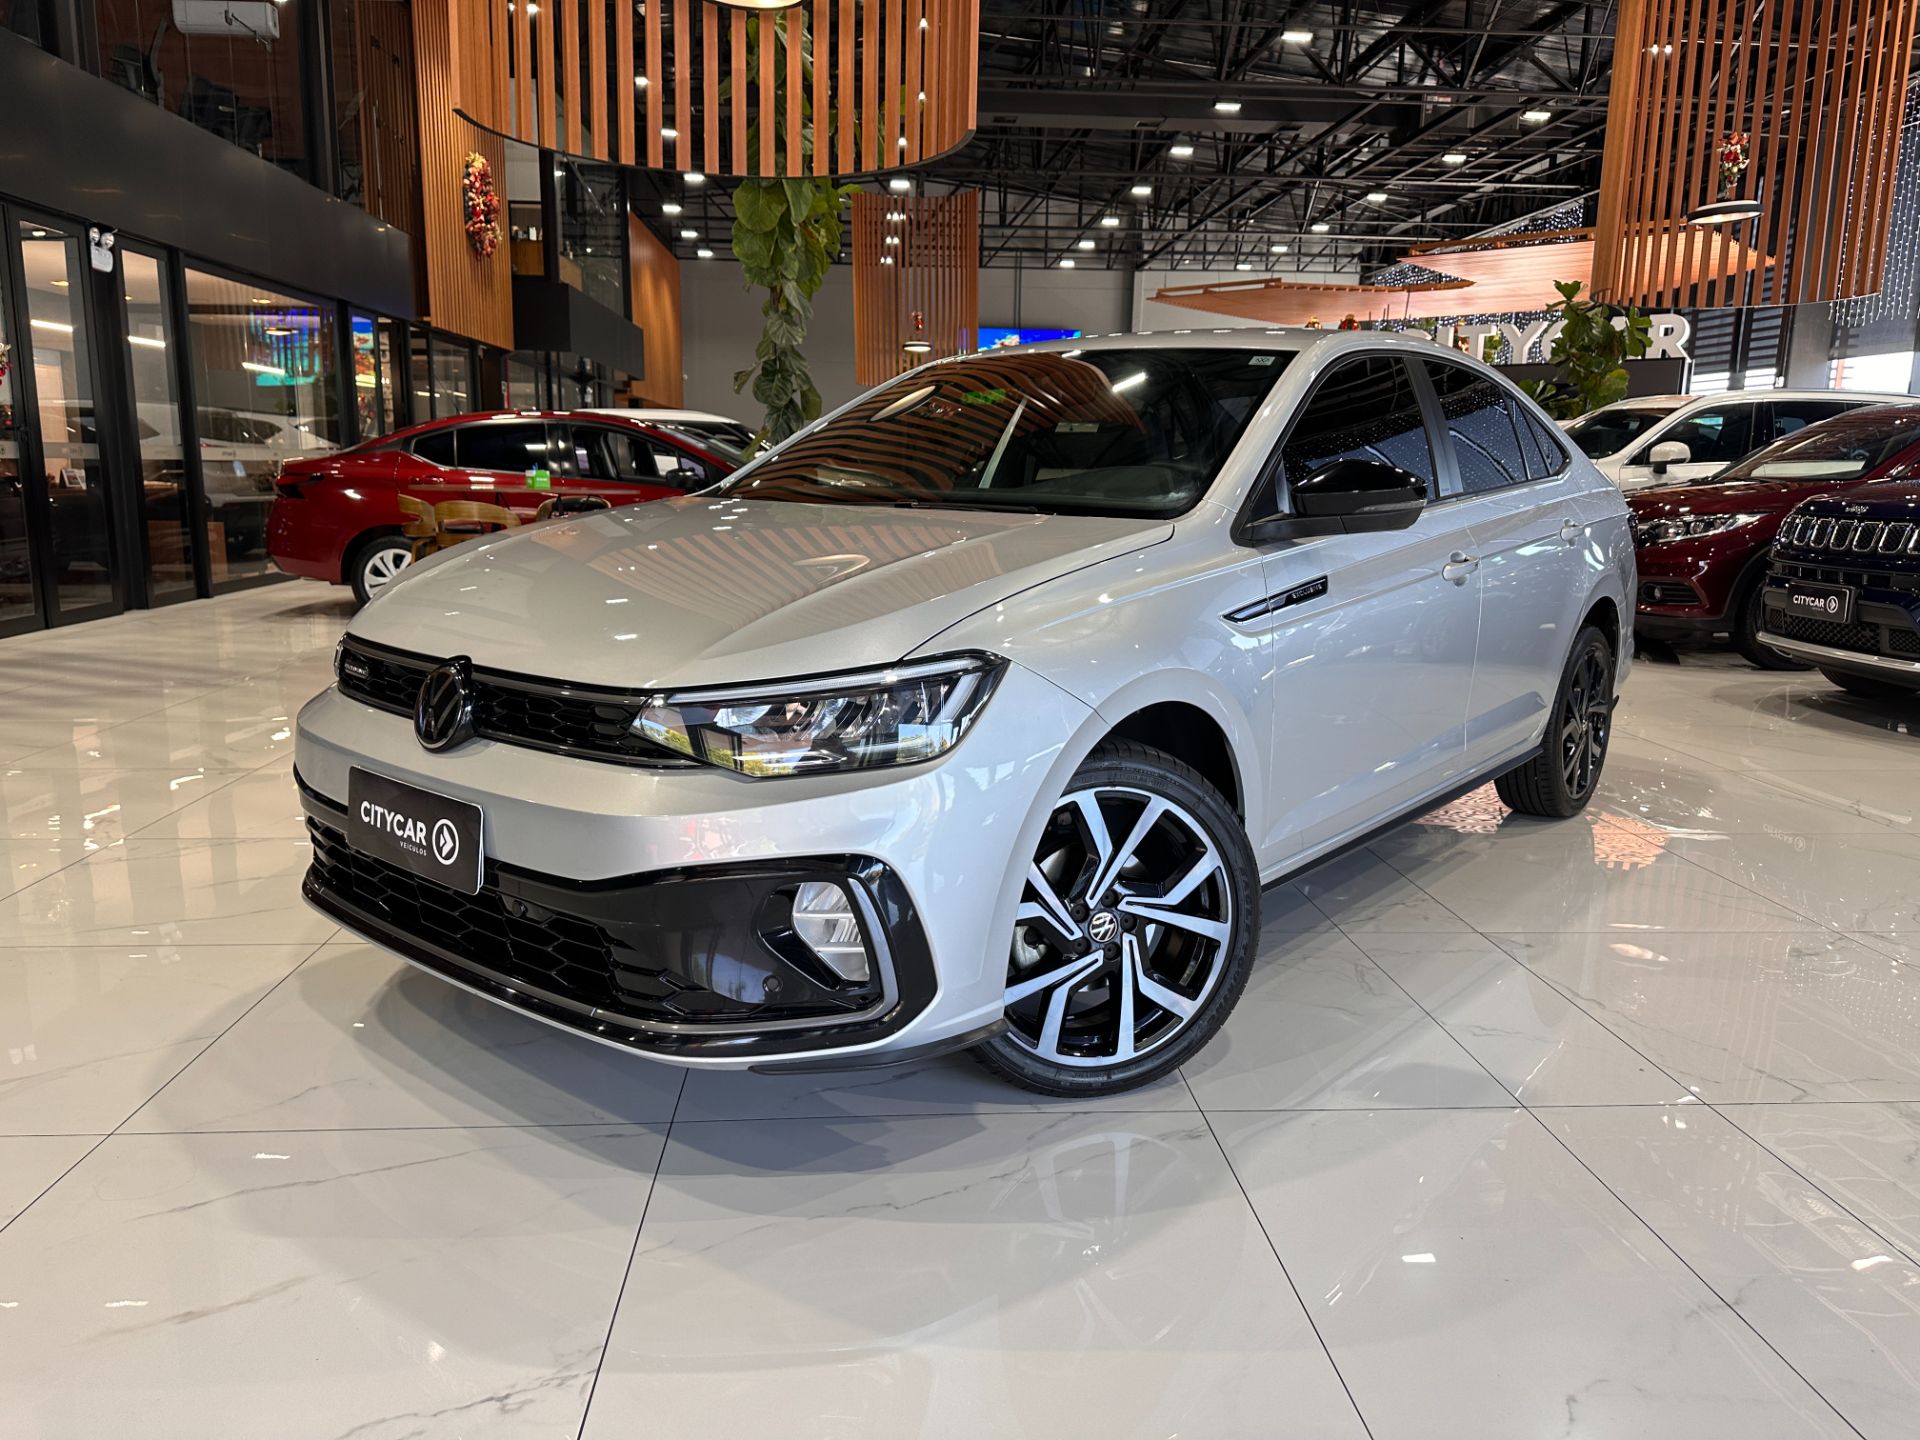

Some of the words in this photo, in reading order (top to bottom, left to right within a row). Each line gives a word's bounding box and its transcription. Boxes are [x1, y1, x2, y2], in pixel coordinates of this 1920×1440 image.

[1402, 313, 1693, 364] ITYR
[1793, 595, 1825, 608] CITYCAR
[360, 800, 427, 846] CITYCAR
